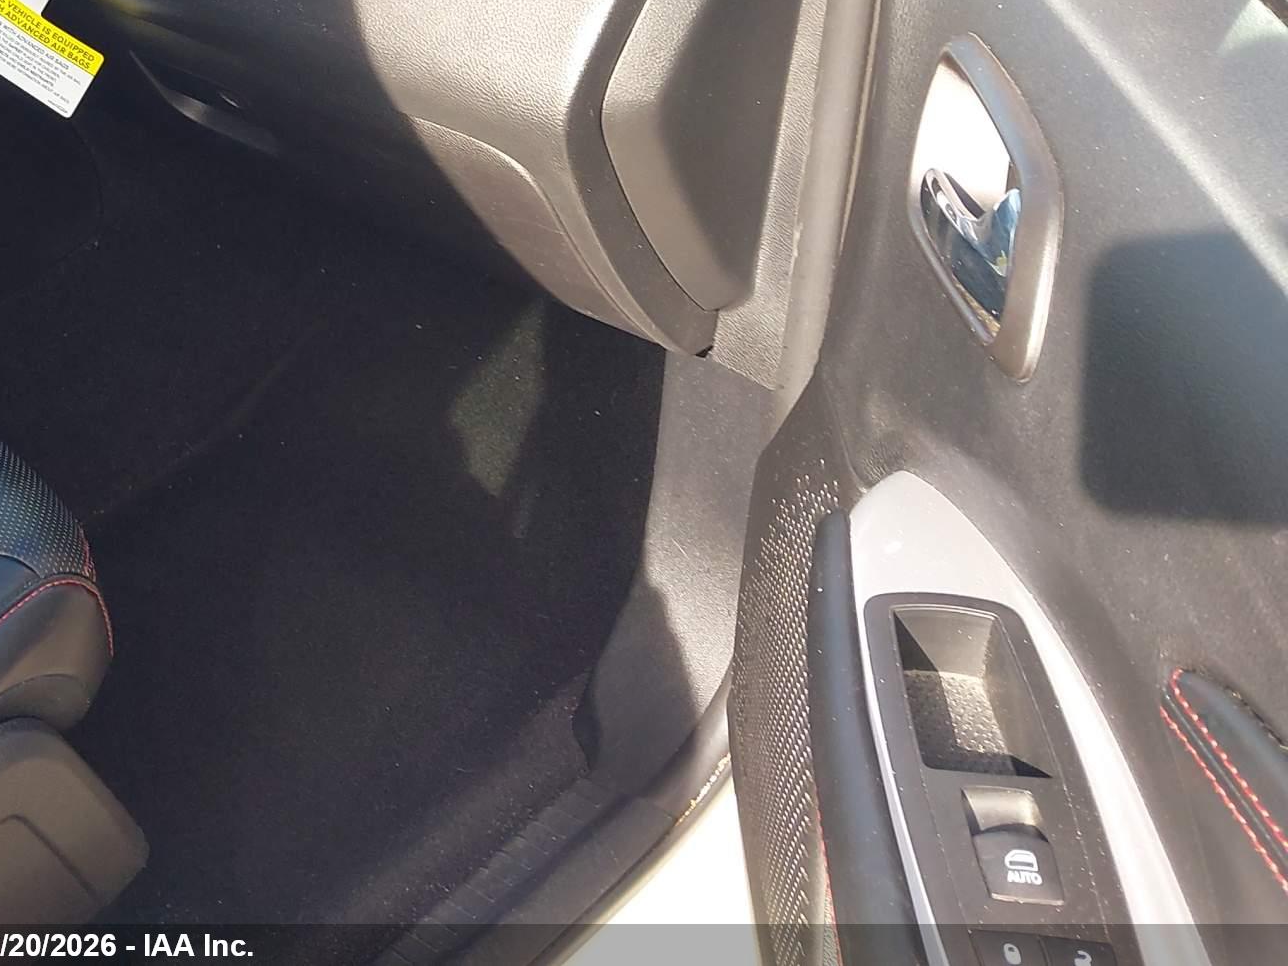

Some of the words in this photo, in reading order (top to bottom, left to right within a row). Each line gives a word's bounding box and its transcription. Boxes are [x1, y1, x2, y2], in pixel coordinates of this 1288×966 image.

[4, 9, 51, 44] ADVANCED
[50, 41, 66, 54] AIR
[66, 50, 91, 70] BAGS
[5, 0, 41, 28] VEHICLE
[41, 25, 51, 35] IS
[51, 30, 95, 64] EQUIPPED
[1006, 870, 1043, 885] AUTO
